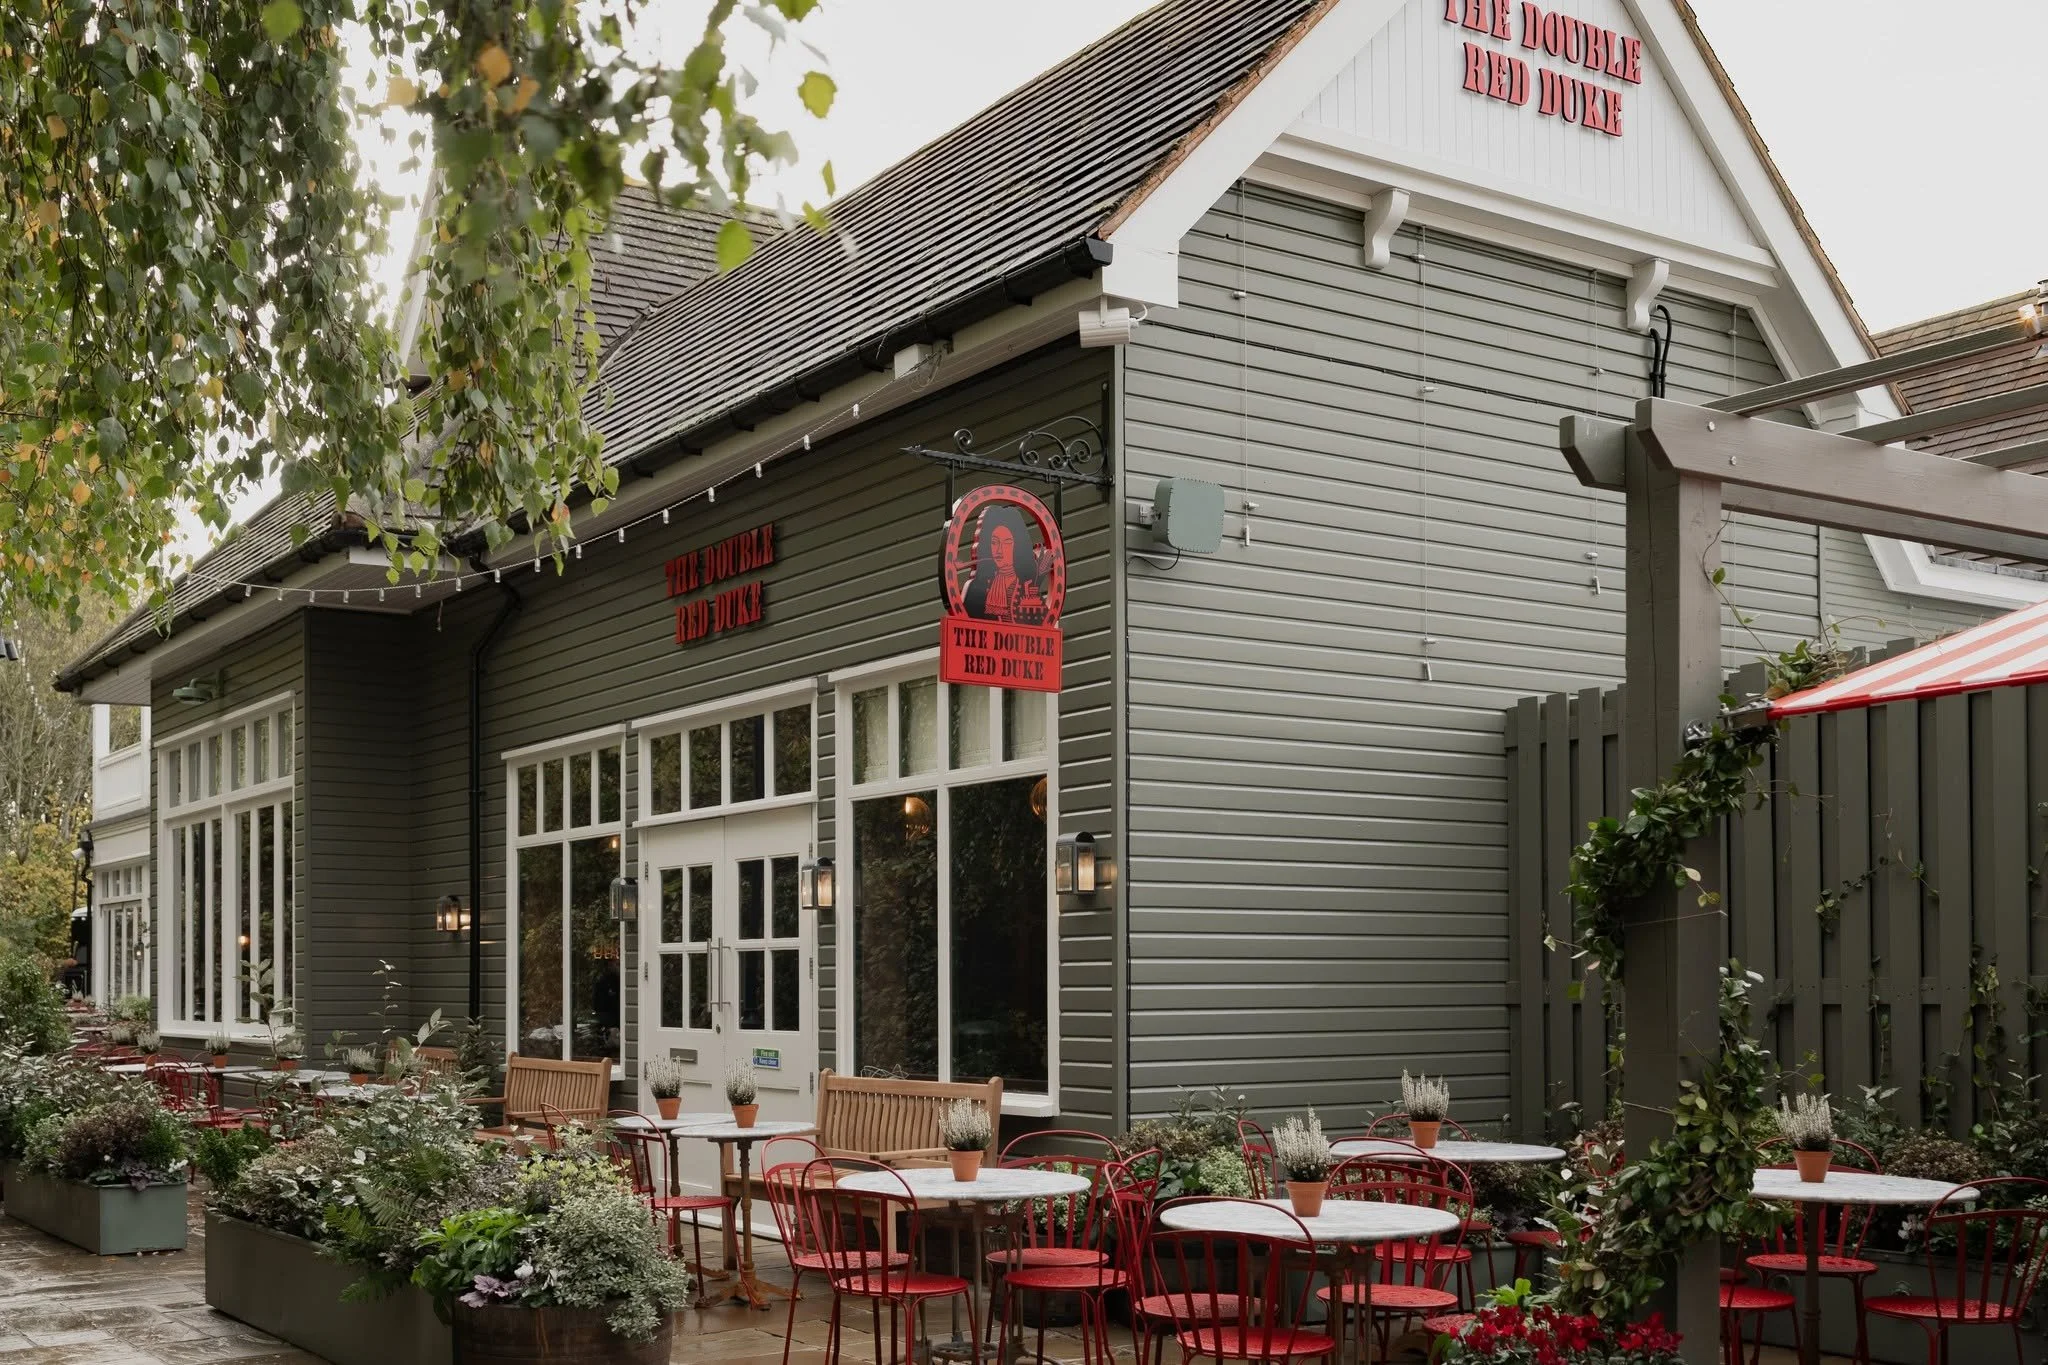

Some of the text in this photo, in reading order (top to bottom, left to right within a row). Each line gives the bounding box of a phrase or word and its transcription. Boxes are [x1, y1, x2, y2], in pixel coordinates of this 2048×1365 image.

[1521, 1, 1642, 84] DOUBLE
[1463, 42, 1623, 137] RED DUKE
[664, 522, 774, 598] THE DOUBLE
[675, 581, 762, 645] RED DUKE
[953, 627, 1054, 656] THE DOUBLE
[964, 654, 1043, 680] RED DUKE
